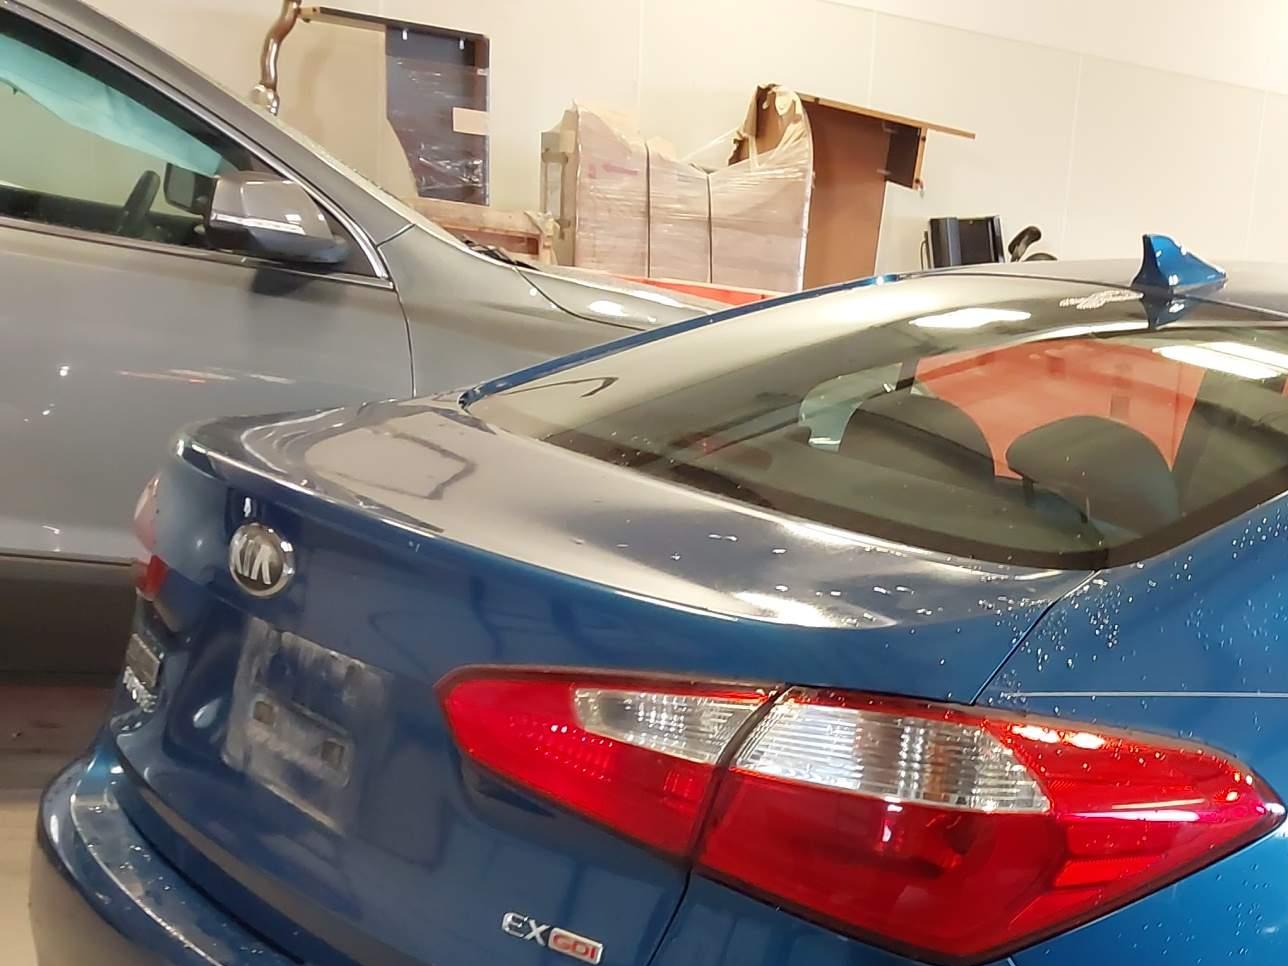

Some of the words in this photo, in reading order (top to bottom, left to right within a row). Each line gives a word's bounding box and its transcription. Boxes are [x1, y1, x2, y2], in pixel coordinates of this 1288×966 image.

[230, 531, 273, 586] KIA
[502, 912, 551, 947] EX
[551, 931, 599, 961] GDI
